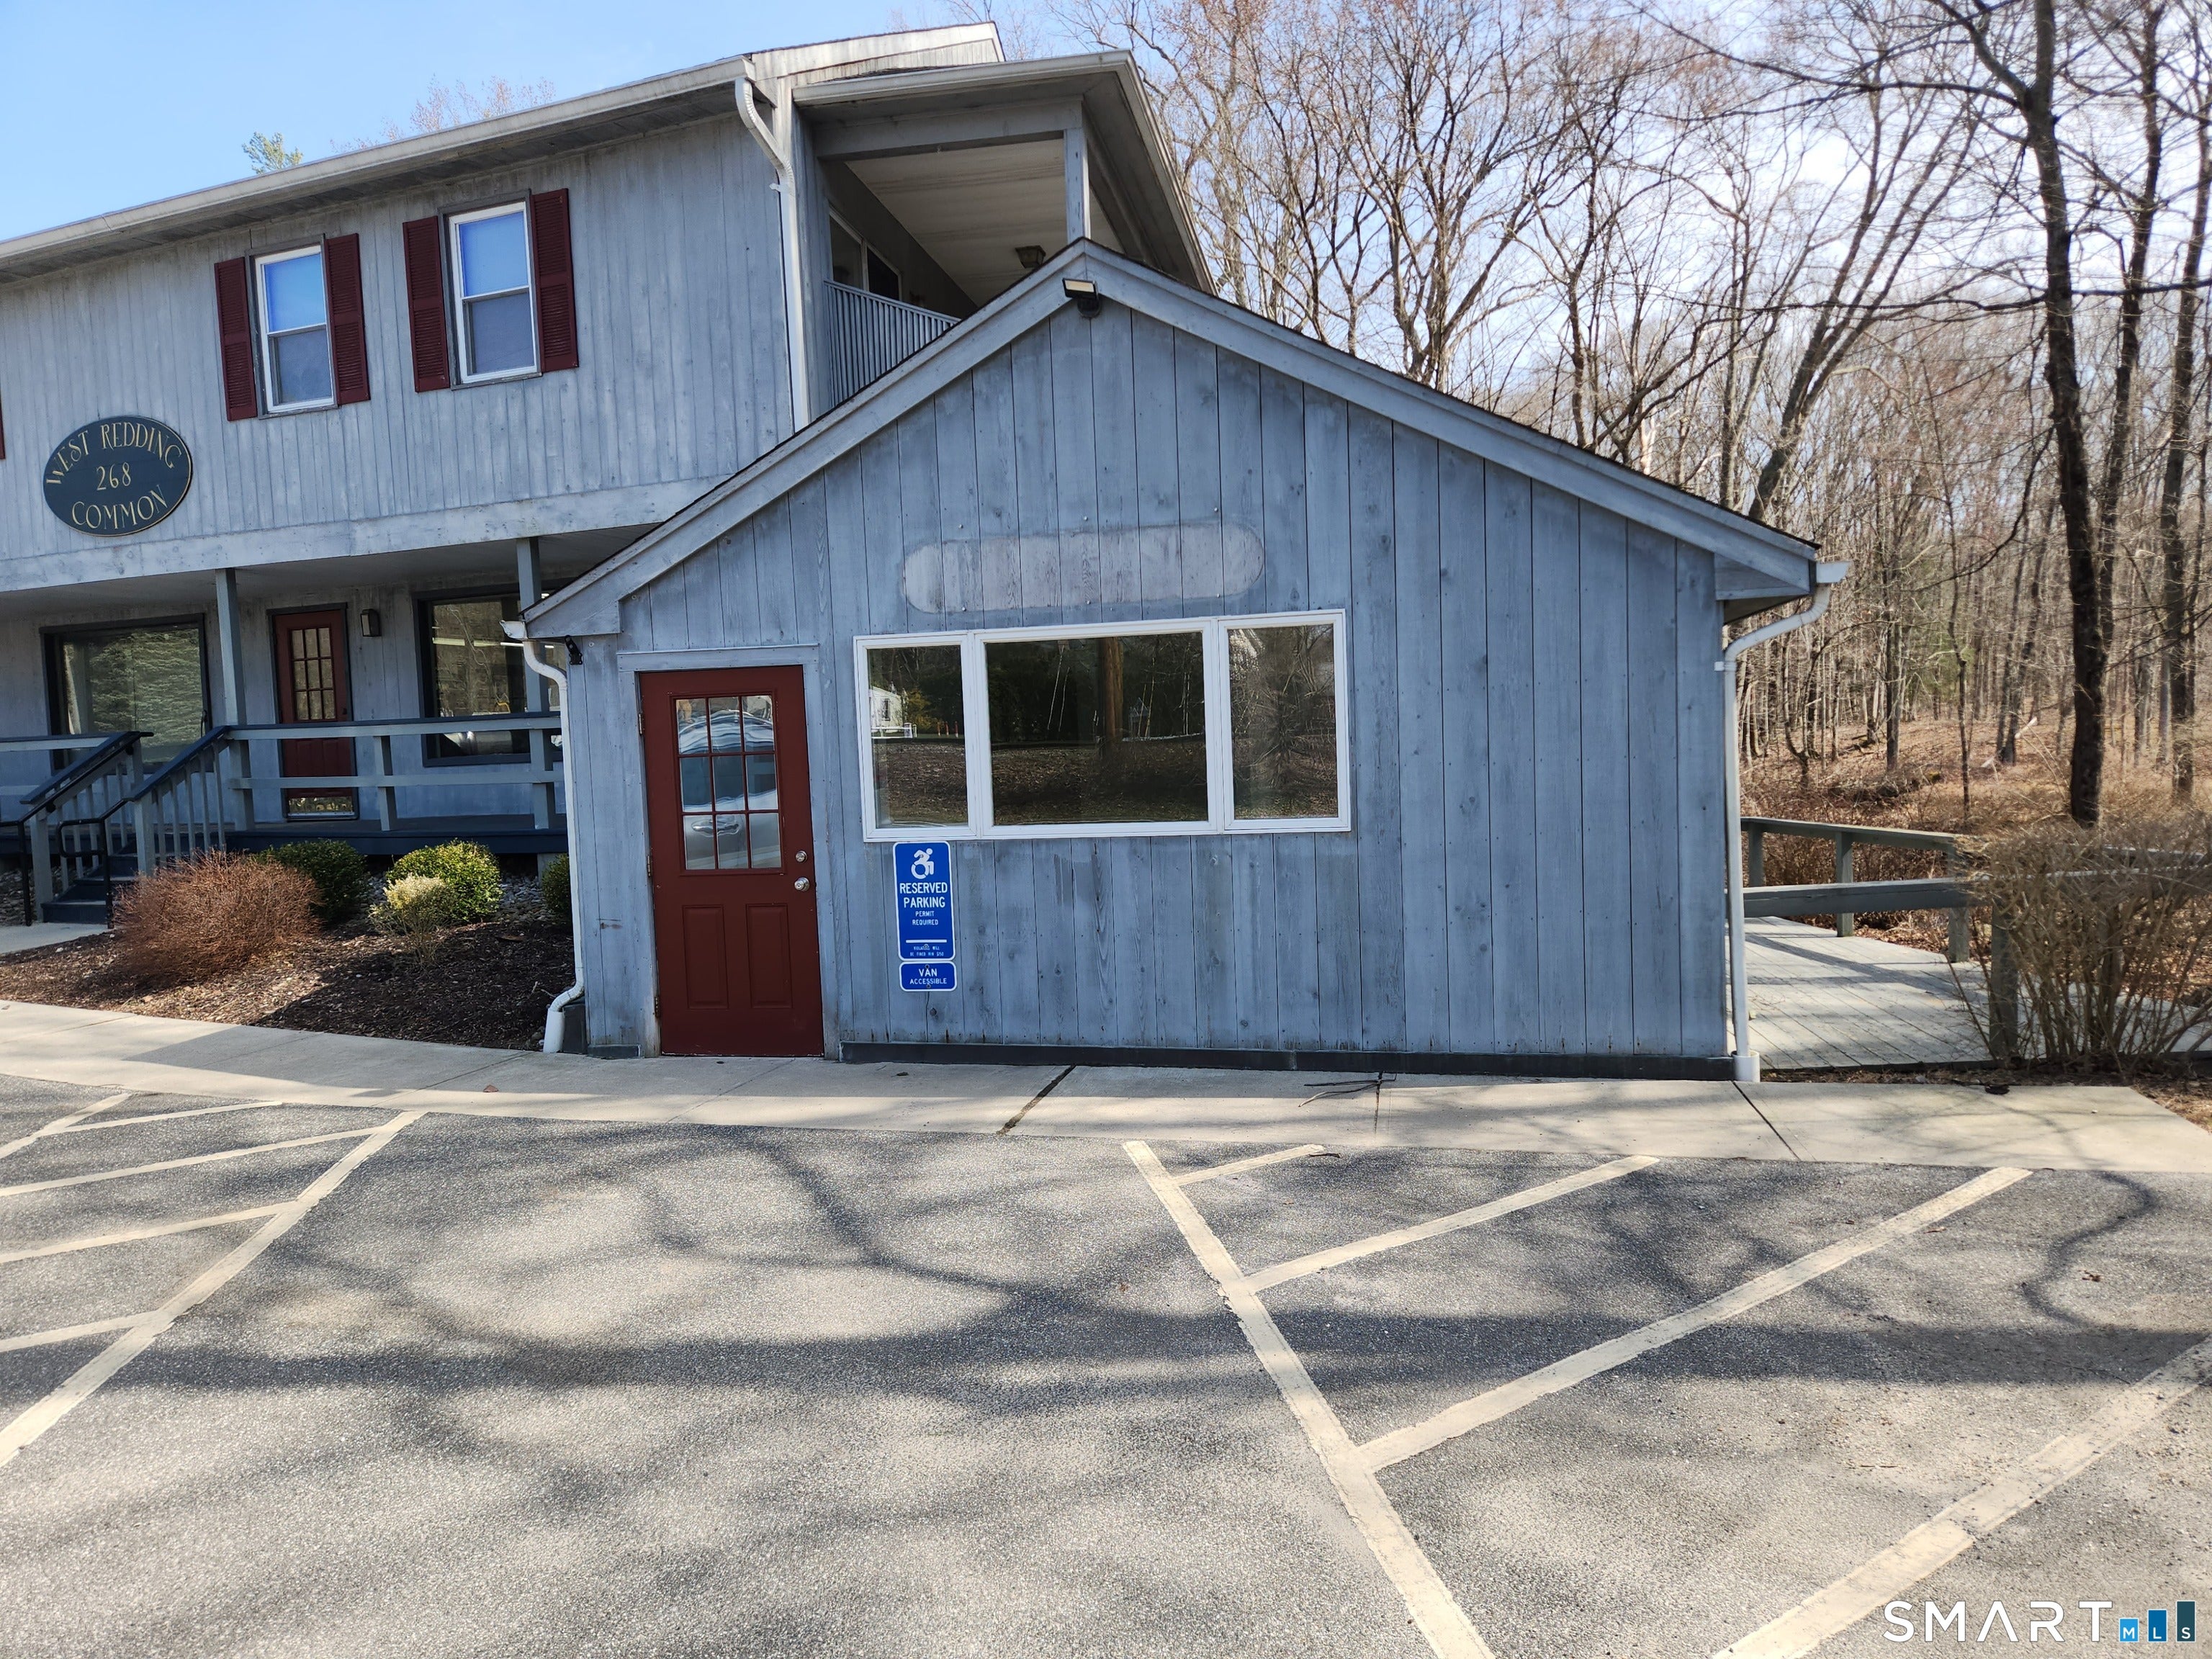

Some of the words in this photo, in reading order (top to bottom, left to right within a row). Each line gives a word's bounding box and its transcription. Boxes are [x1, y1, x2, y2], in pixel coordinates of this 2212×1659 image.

[46, 430, 89, 485] WEST
[101, 422, 182, 469] REDDING
[96, 462, 131, 491] 268
[72, 485, 168, 529] COMMON
[899, 882, 948, 894] RESERVED
[904, 896, 945, 908] PARKING
[918, 968, 938, 977] VAN
